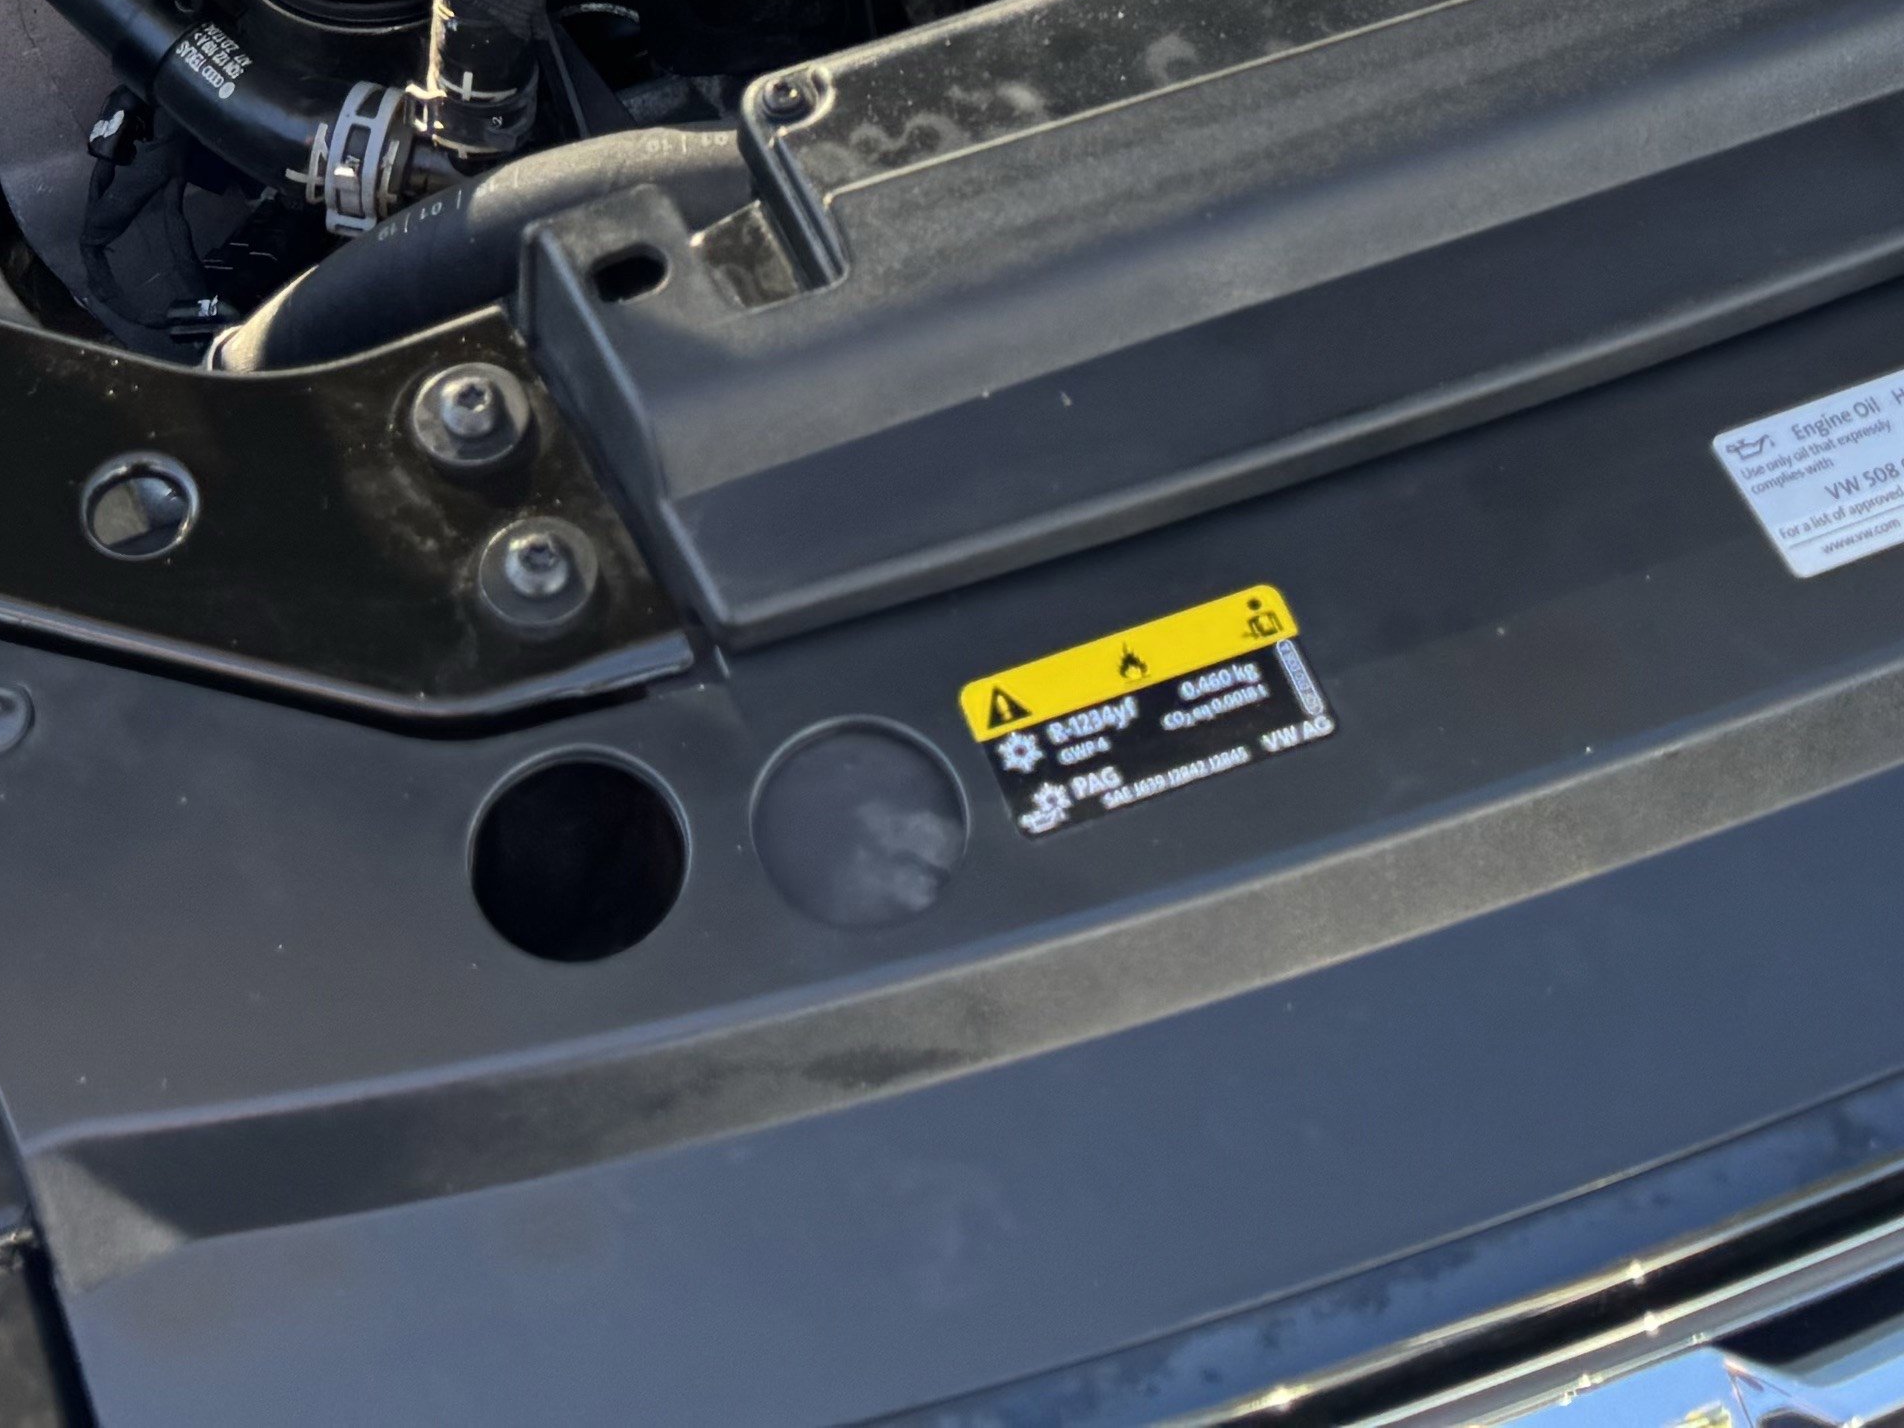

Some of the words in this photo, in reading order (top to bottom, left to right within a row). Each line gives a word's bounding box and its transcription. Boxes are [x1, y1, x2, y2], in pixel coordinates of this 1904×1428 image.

[1790, 410, 1853, 441] Engine
[1852, 395, 1881, 418] Oil
[1740, 464, 1766, 480] Use
[1765, 454, 1793, 472] only
[1792, 446, 1810, 462] oil
[1807, 438, 1837, 456] that
[1836, 419, 1892, 446] expressly
[1750, 469, 1805, 494] complies
[1804, 457, 1835, 474] with
[1823, 475, 1860, 499] VW
[1862, 462, 1900, 487] 508
[1778, 524, 1800, 539] For
[1802, 523, 1811, 533] a
[1808, 512, 1831, 528] list
[1831, 504, 1846, 521] of
[1821, 518, 1901, 554] www.vw.com
[1047, 696, 1136, 748] R-1234yf
[1180, 668, 1234, 699] 0.460
[1231, 663, 1260, 683] kg
[1262, 725, 1298, 751] VW
[1302, 714, 1333, 739] AG
[1071, 766, 1121, 798] PAG
